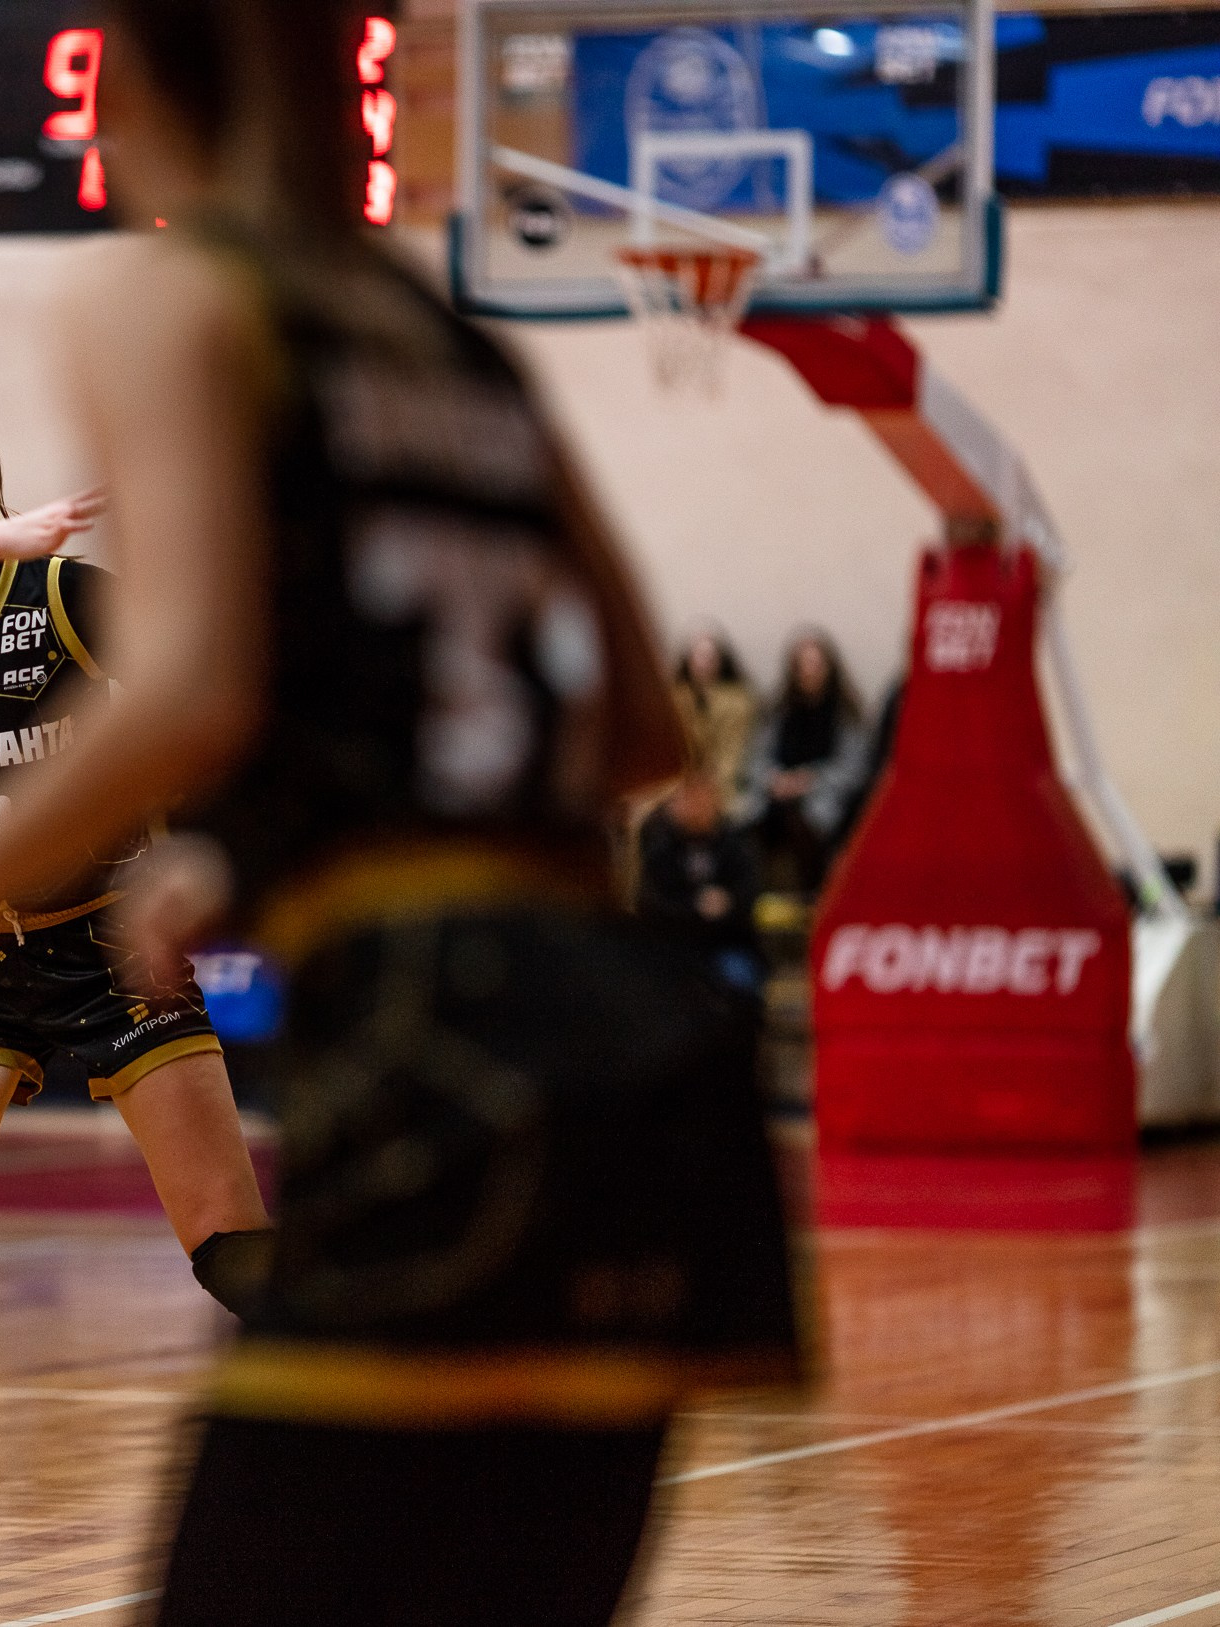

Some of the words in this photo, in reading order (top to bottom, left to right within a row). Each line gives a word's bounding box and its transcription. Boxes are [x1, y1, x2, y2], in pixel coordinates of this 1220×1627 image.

[41, 27, 104, 140] 9
[1143, 75, 1220, 128] FO
[0, 628, 46, 654] BET
[1, 608, 47, 634] FON
[819, 921, 1102, 997] FONBET
[111, 1010, 181, 1051] ХИМПРОМ
